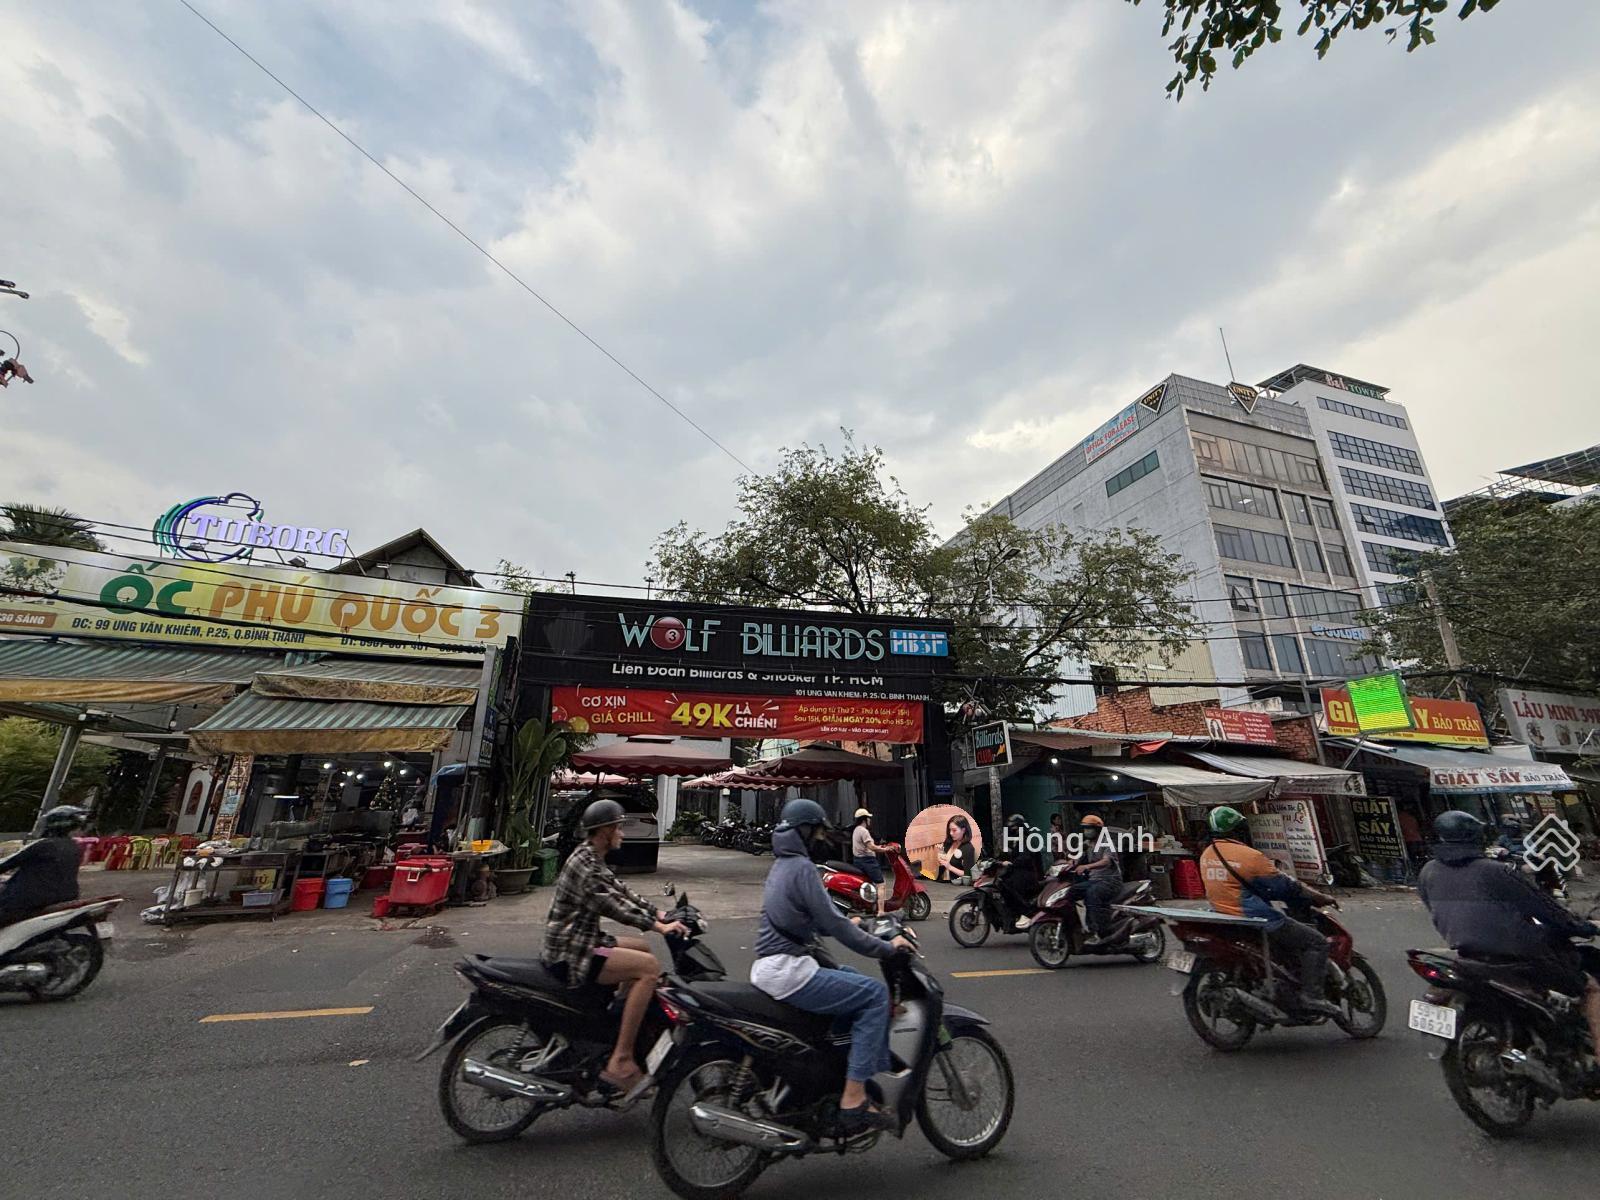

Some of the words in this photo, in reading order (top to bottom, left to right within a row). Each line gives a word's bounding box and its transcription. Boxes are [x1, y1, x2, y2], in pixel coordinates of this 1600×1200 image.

[1143, 387, 1164, 405] UNITY
[1232, 386, 1256, 399] UNITY
[1086, 436, 1105, 454] OFFICE
[1116, 414, 1135, 432] LEASE
[189, 512, 349, 557] TUBORG
[100, 561, 194, 615] ỐC
[208, 576, 316, 625] PHÚ
[330, 587, 463, 637] QUỐC
[474, 603, 500, 639] 3
[15, 613, 46, 624] SÁNG
[72, 617, 92, 629] ĐC:
[95, 618, 110, 631] 99
[206, 627, 231, 639] P.25,
[740, 622, 886, 662] BILLIARDS
[581, 695, 602, 707] CƠ
[604, 695, 626, 709] XỊN
[735, 702, 751, 715] LÀ
[810, 706, 827, 715] dụng
[591, 711, 614, 724] GIÁ
[616, 711, 655, 724] CHILL
[671, 702, 734, 728] 49K
[843, 715, 864, 724] NGAY
[1545, 703, 1579, 722] MINI
[975, 727, 1004, 748] Billiards
